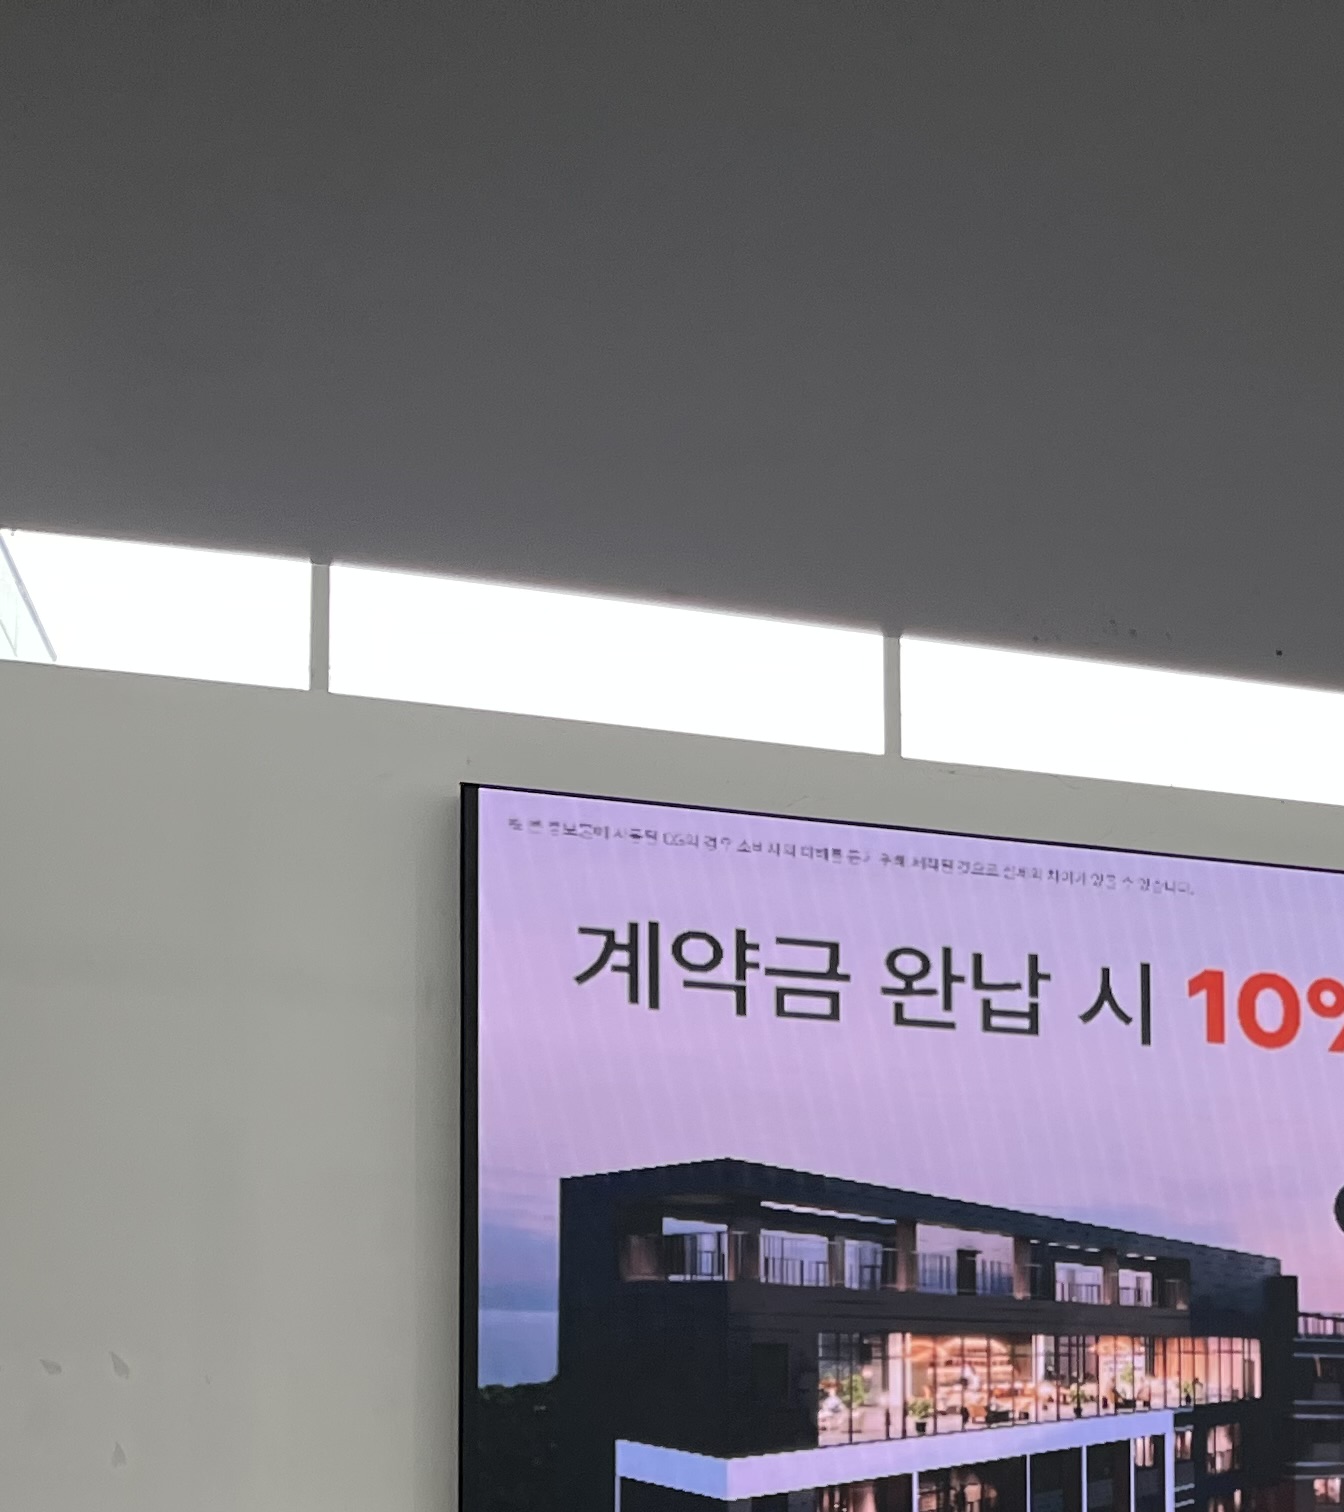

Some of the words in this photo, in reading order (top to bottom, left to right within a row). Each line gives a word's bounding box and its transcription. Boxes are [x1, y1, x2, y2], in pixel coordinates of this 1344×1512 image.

[574, 920, 850, 1022] 계약금
[881, 946, 1052, 1036] 완납
[1078, 962, 1153, 1046] 시
